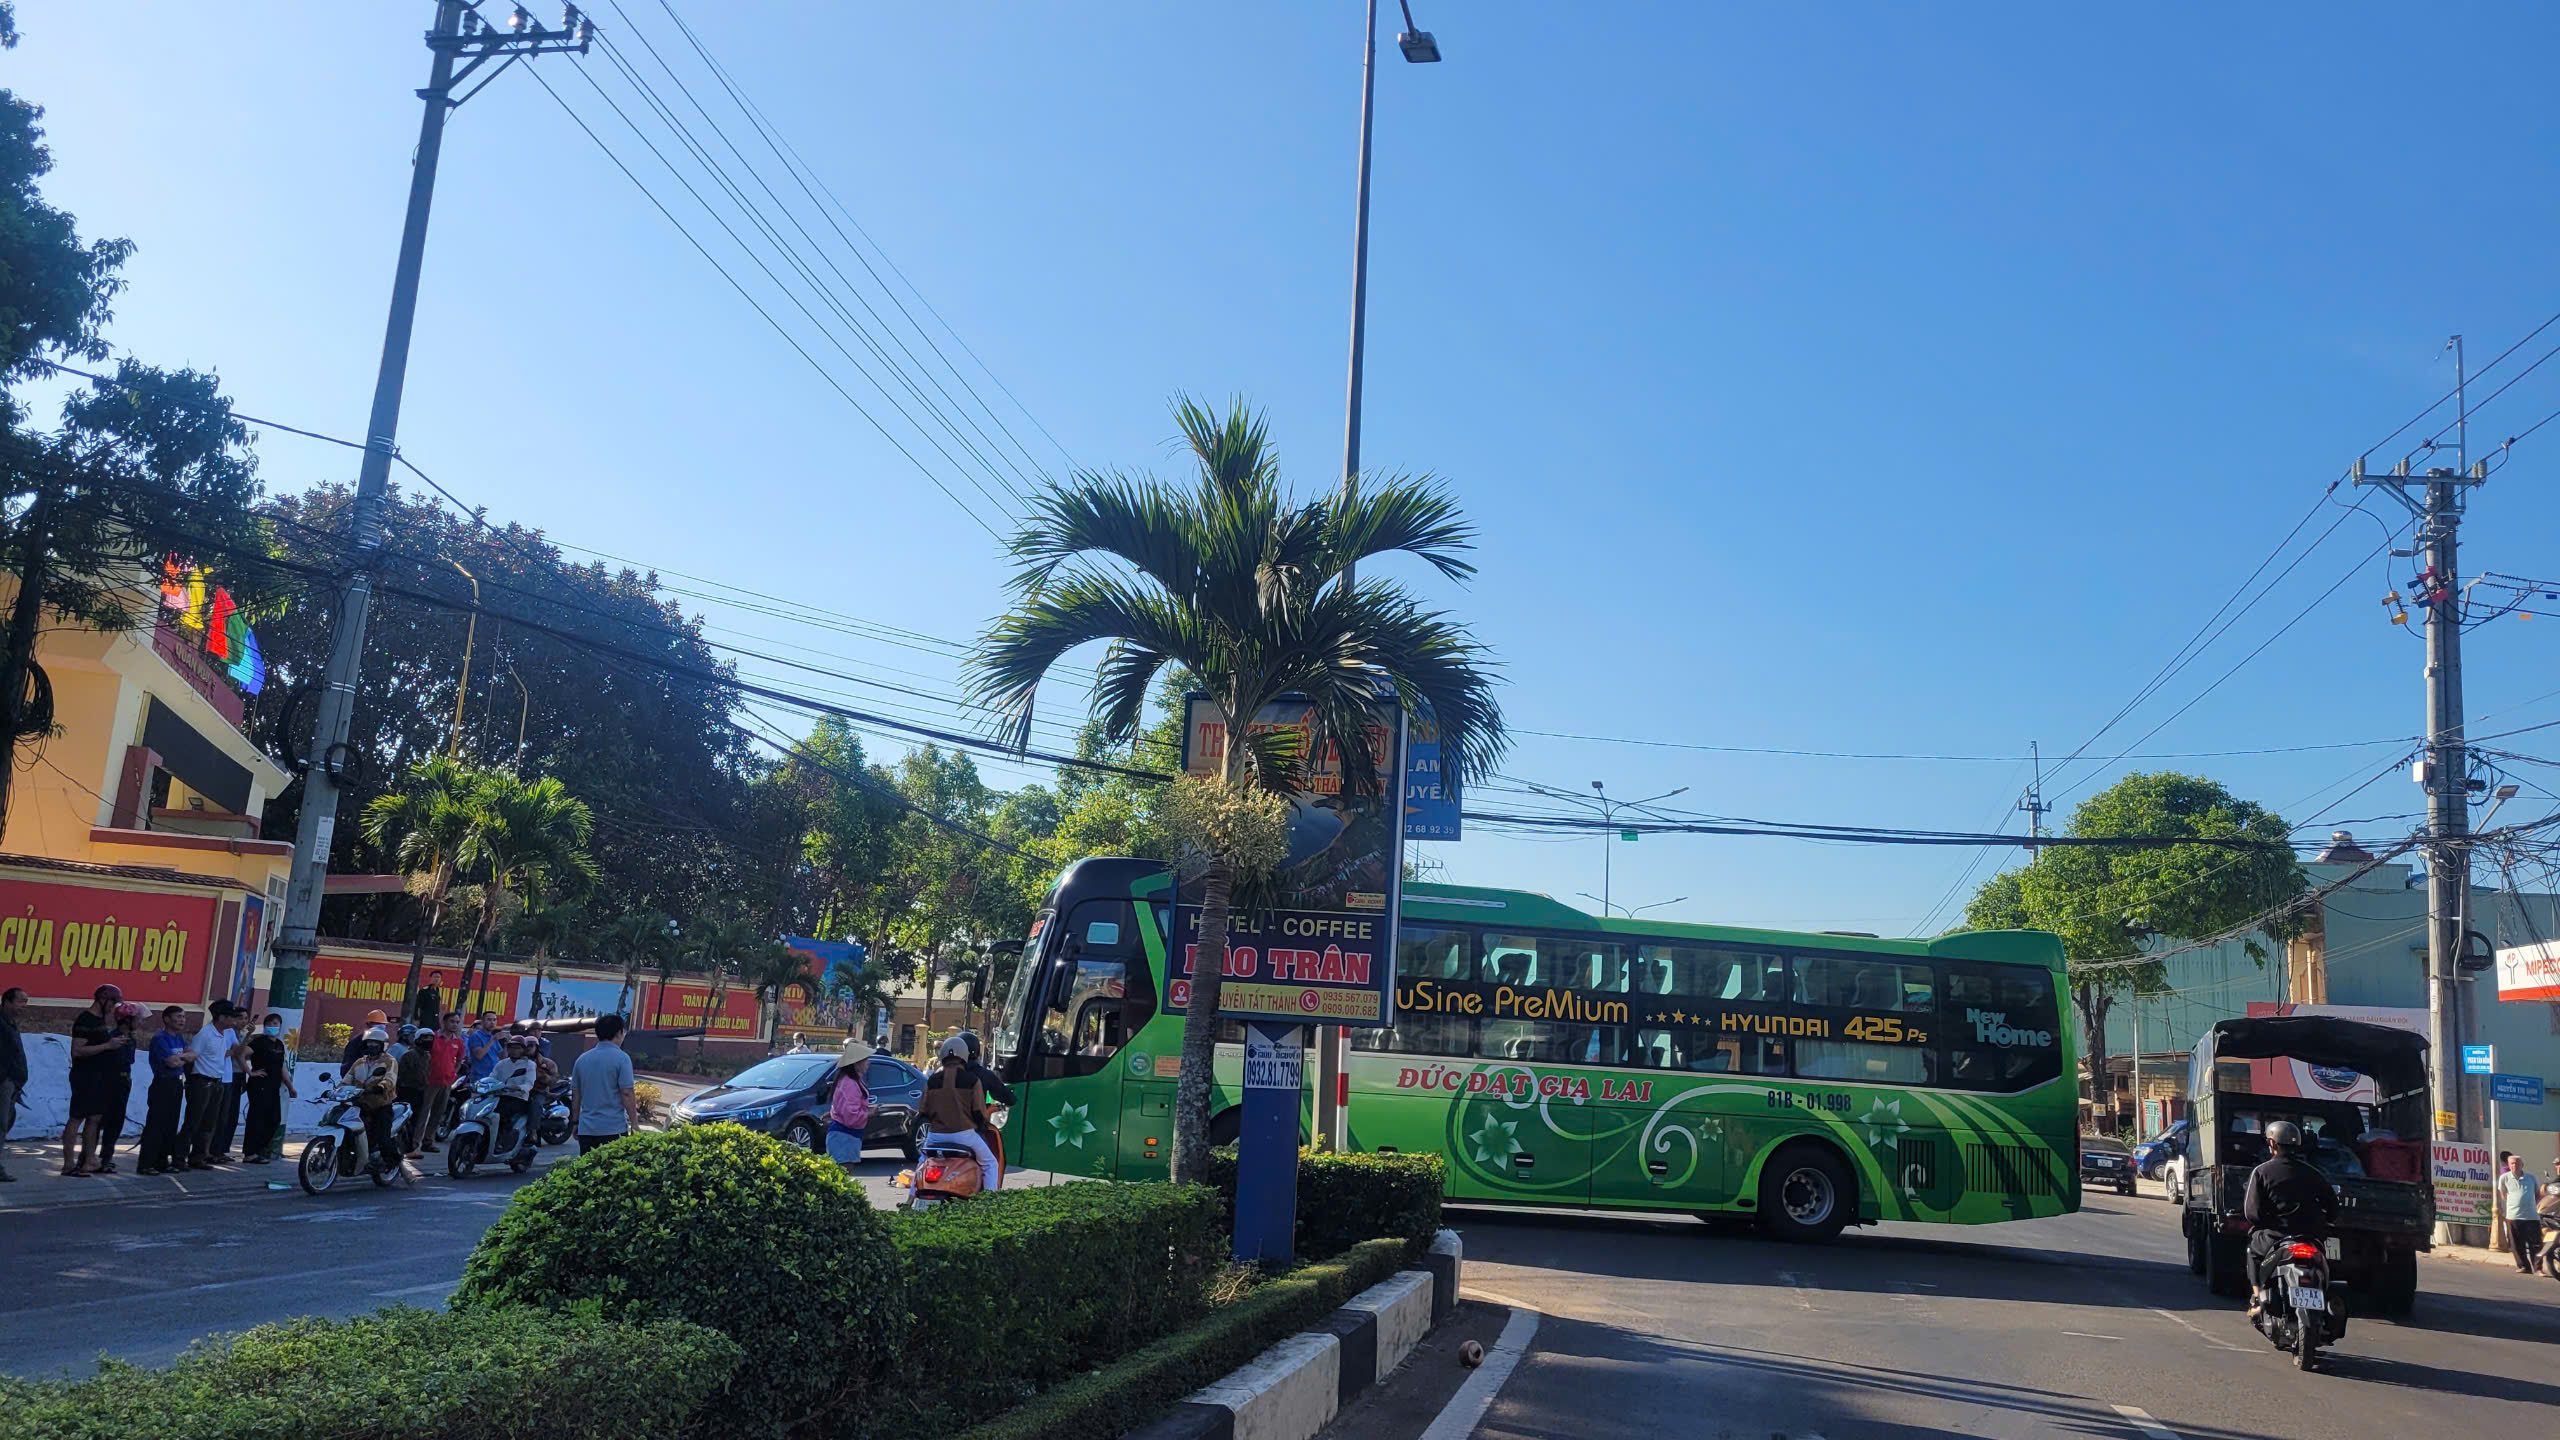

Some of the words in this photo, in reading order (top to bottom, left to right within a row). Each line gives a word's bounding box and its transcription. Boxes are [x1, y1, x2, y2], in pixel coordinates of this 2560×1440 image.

[1408, 759, 1440, 772] AM
[1314, 773, 1342, 794] THÂ
[1415, 825, 1426, 833] 68
[1430, 825, 1440, 834] 92
[1190, 913, 1261, 934] HTEL
[1283, 917, 1372, 940] COFFEE
[0, 905, 54, 966] CỦA
[60, 915, 139, 976] QUÂN
[140, 920, 188, 982] ĐỘI
[1268, 943, 1372, 984] TRÂN
[1248, 987, 1265, 1010] TẤT
[1267, 991, 1297, 1013] THÀNH
[1323, 991, 1379, 1005] 0935.567.079
[1322, 1004, 1378, 1017] 0909.007.682
[1966, 1007, 2006, 1024] New
[1721, 1012, 1829, 1038] HYUNDAI
[1844, 1015, 1903, 1042] 425
[1976, 1021, 2052, 1048] Home
[1246, 1060, 1300, 1087] 0932.81.7799
[1396, 1063, 1462, 1091] ĐỨC
[1466, 1071, 1532, 1098] ĐẠT
[1539, 1076, 1591, 1099] GIA
[1601, 1078, 1653, 1102] LAI
[1767, 1089, 1793, 1109] 81B
[2433, 1146, 2459, 1164] VỰA
[2463, 1146, 2490, 1165] DỪA
[2434, 1164, 2467, 1182] Phương
[2468, 1167, 2489, 1181] Thảo
